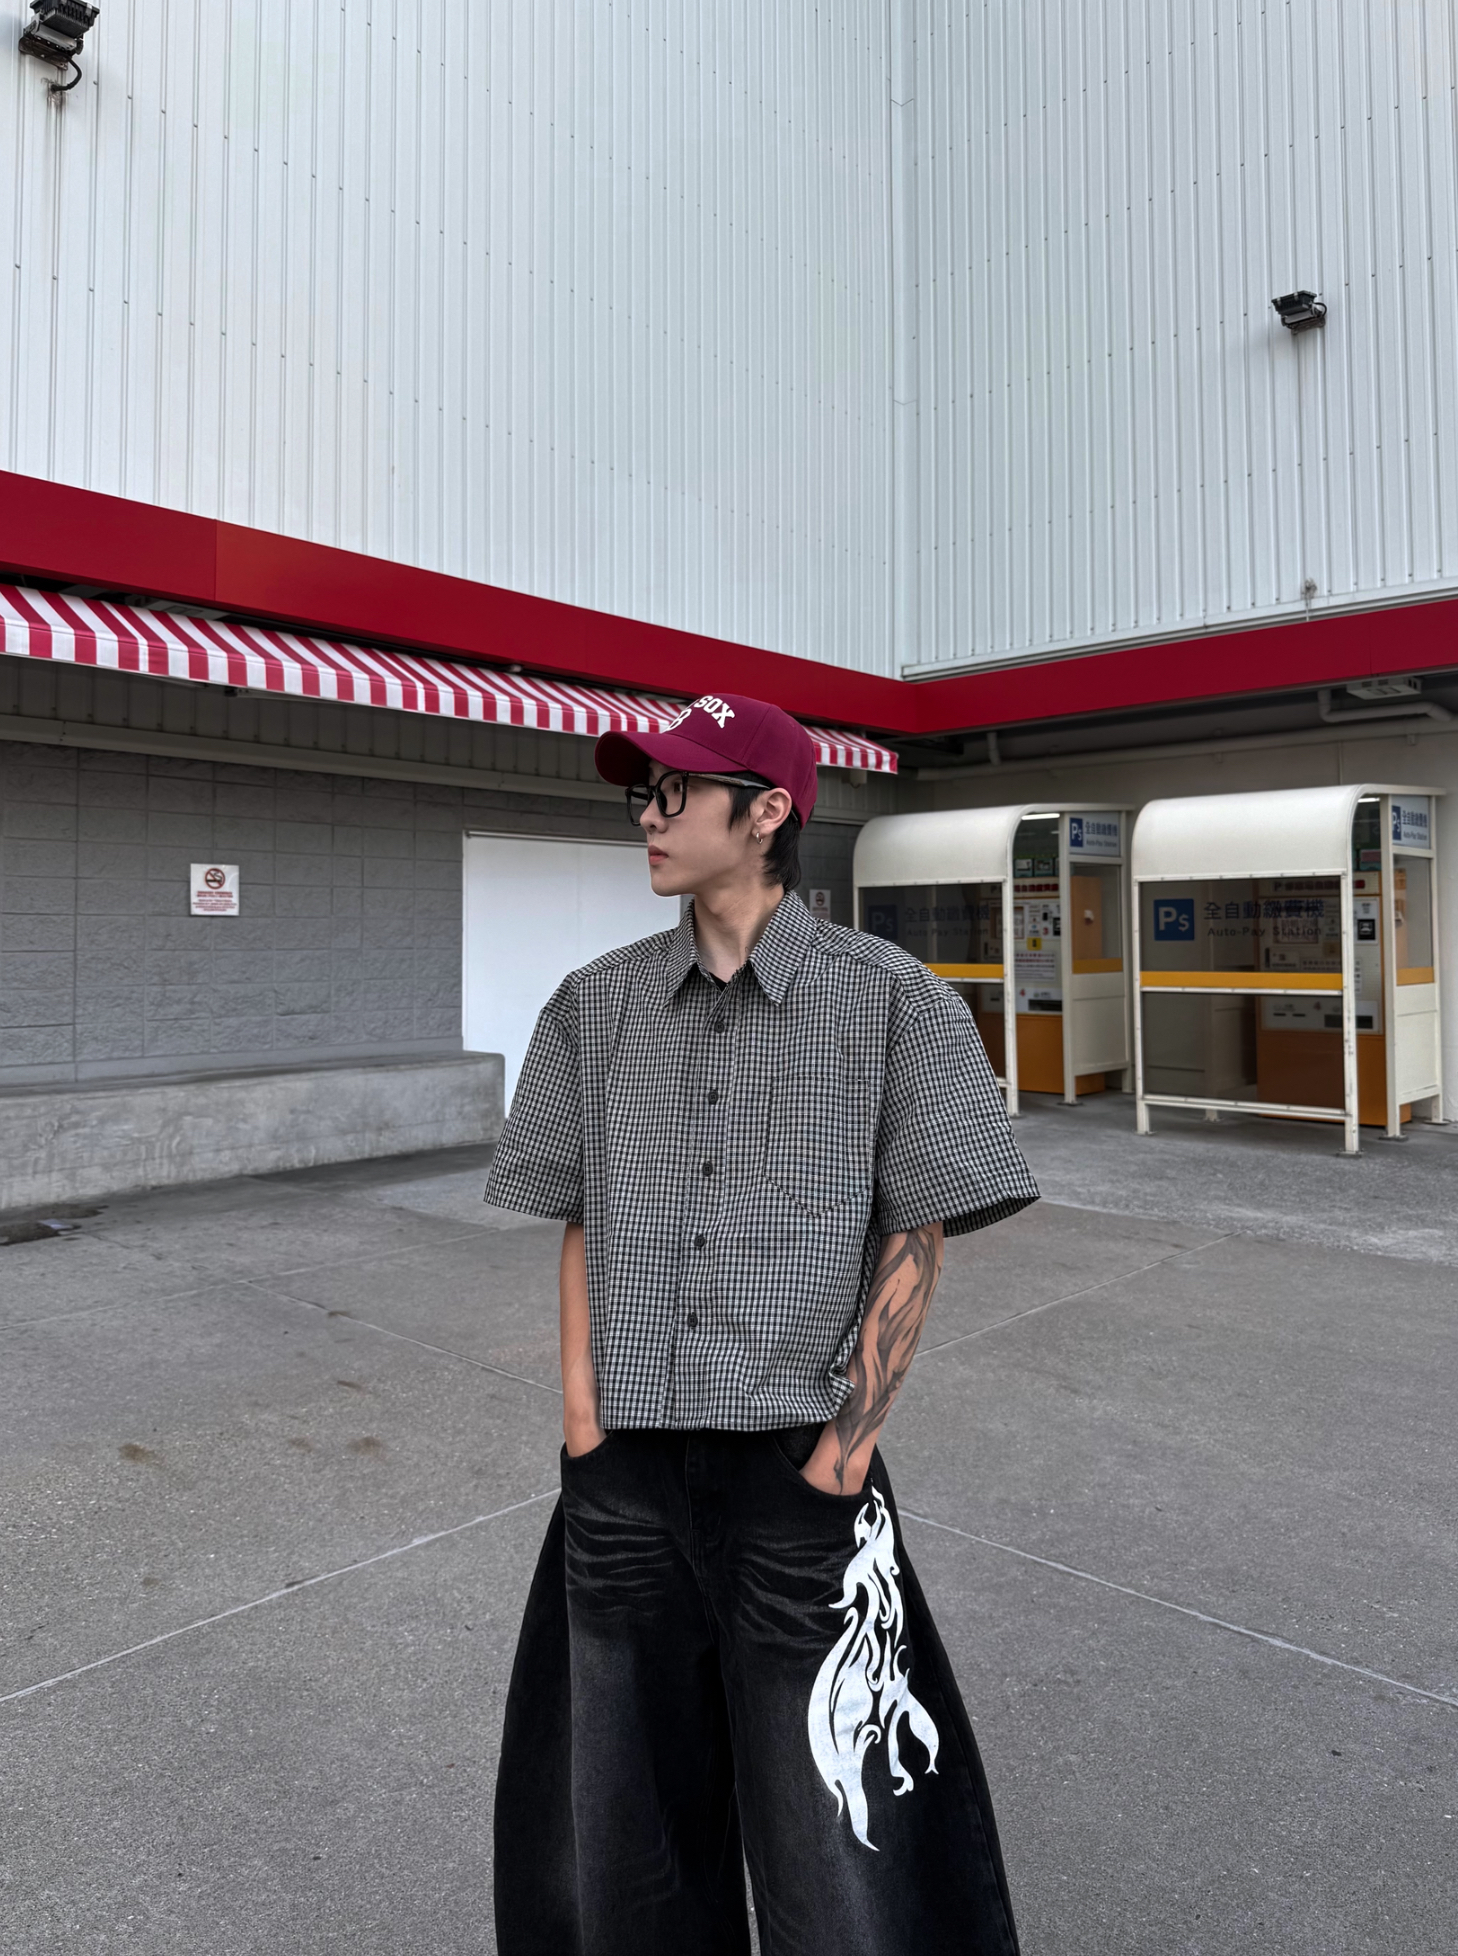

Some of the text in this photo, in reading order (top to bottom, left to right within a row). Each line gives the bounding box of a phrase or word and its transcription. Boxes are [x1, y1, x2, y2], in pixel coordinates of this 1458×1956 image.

[693, 695, 735, 728] SOX
[1204, 900, 1324, 919] 全自動繳費機
[1207, 927, 1266, 938] Auto-Pay
[1273, 925, 1321, 936] Station
